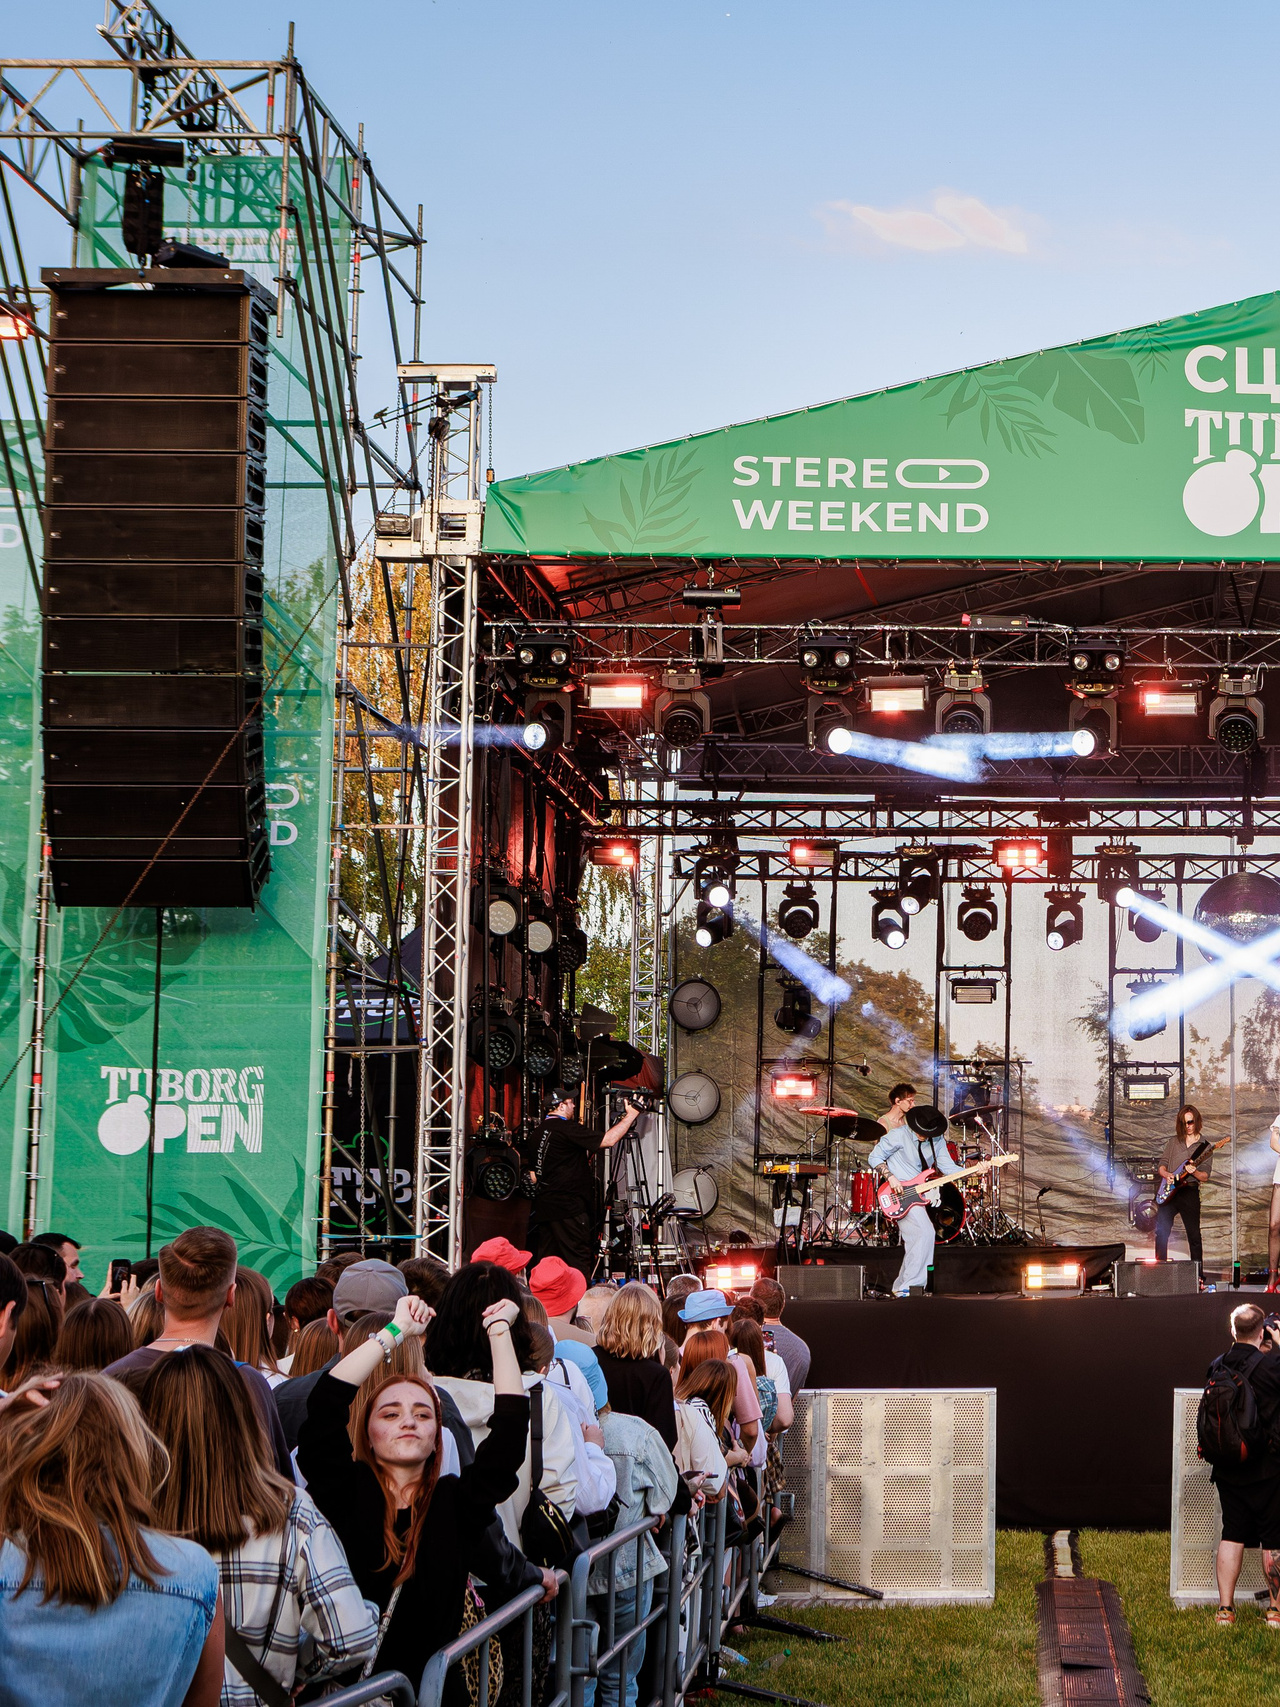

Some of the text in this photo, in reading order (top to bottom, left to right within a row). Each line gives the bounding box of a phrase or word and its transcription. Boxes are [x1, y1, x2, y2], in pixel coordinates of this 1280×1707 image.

[732, 499, 989, 533] WEEKEND
[100, 1065, 265, 1105] TUBORG
[536, 1129, 549, 1176] blackout
